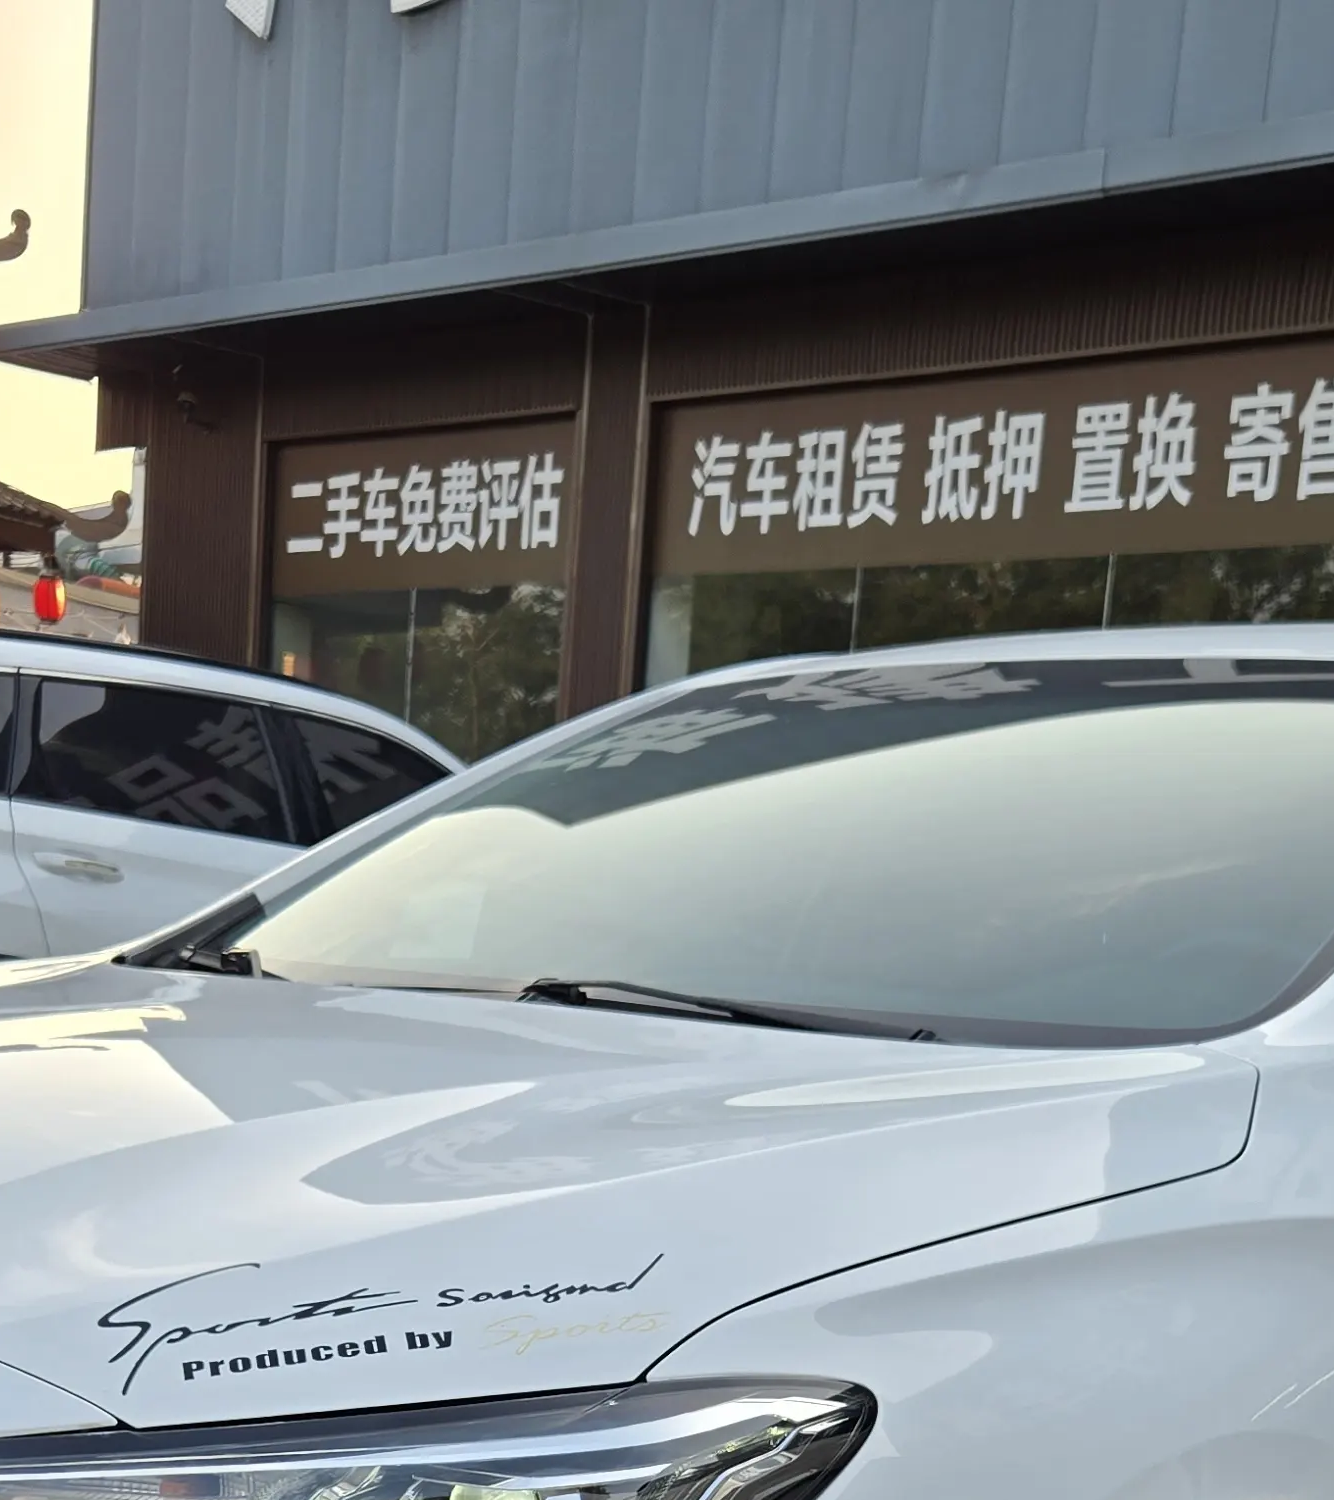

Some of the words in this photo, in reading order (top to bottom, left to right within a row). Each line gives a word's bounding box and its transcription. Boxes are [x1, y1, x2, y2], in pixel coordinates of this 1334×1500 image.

[287, 451, 565, 559] 二手车免费评估
[687, 420, 904, 537] 汽车租赁
[921, 410, 1047, 523] 抵押
[1064, 393, 1198, 514] 置换
[182, 1334, 388, 1381] Produced
[407, 1329, 454, 1356] by
